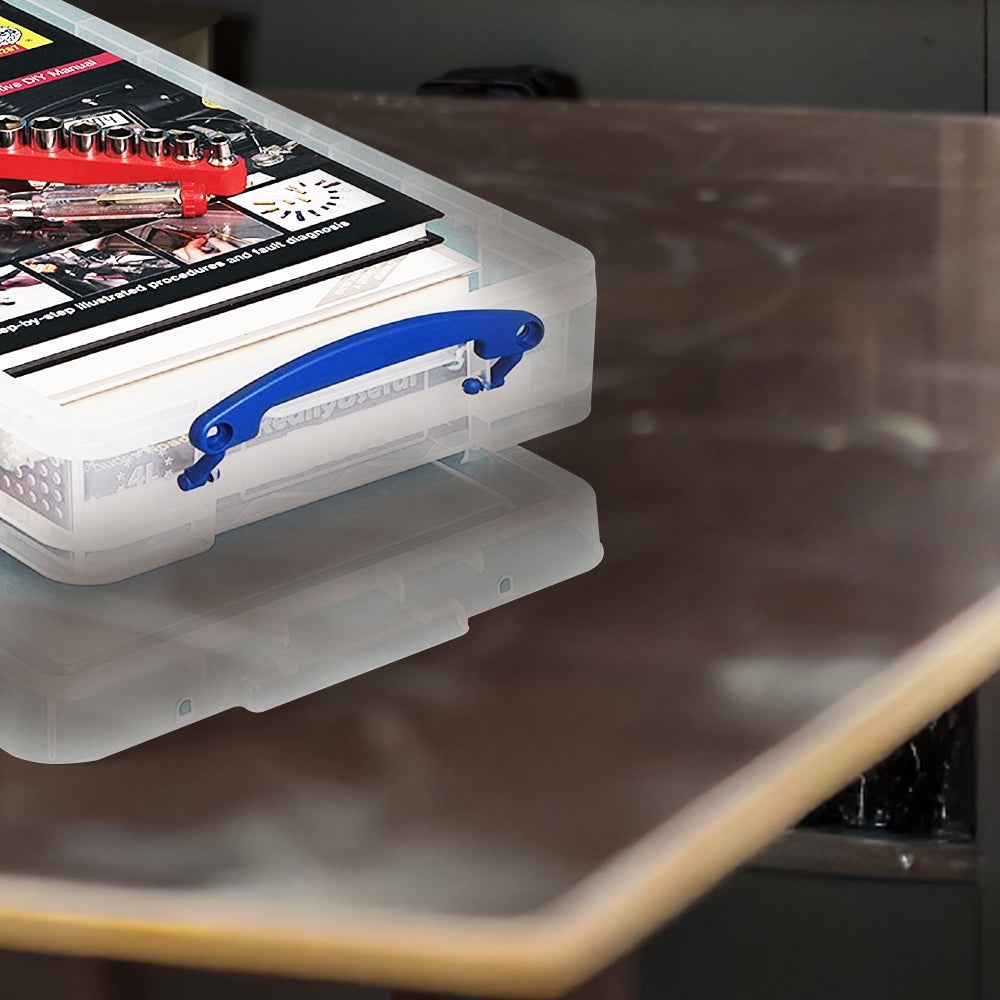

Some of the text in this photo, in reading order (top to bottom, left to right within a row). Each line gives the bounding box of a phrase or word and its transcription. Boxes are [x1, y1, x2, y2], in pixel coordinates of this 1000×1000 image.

[22, 73, 47, 85] DIY
[47, 59, 98, 78] Manual
[149, 260, 226, 289] procedures
[226, 251, 253, 264] and
[251, 241, 286, 256] fault
[285, 220, 351, 245] diagnosis
